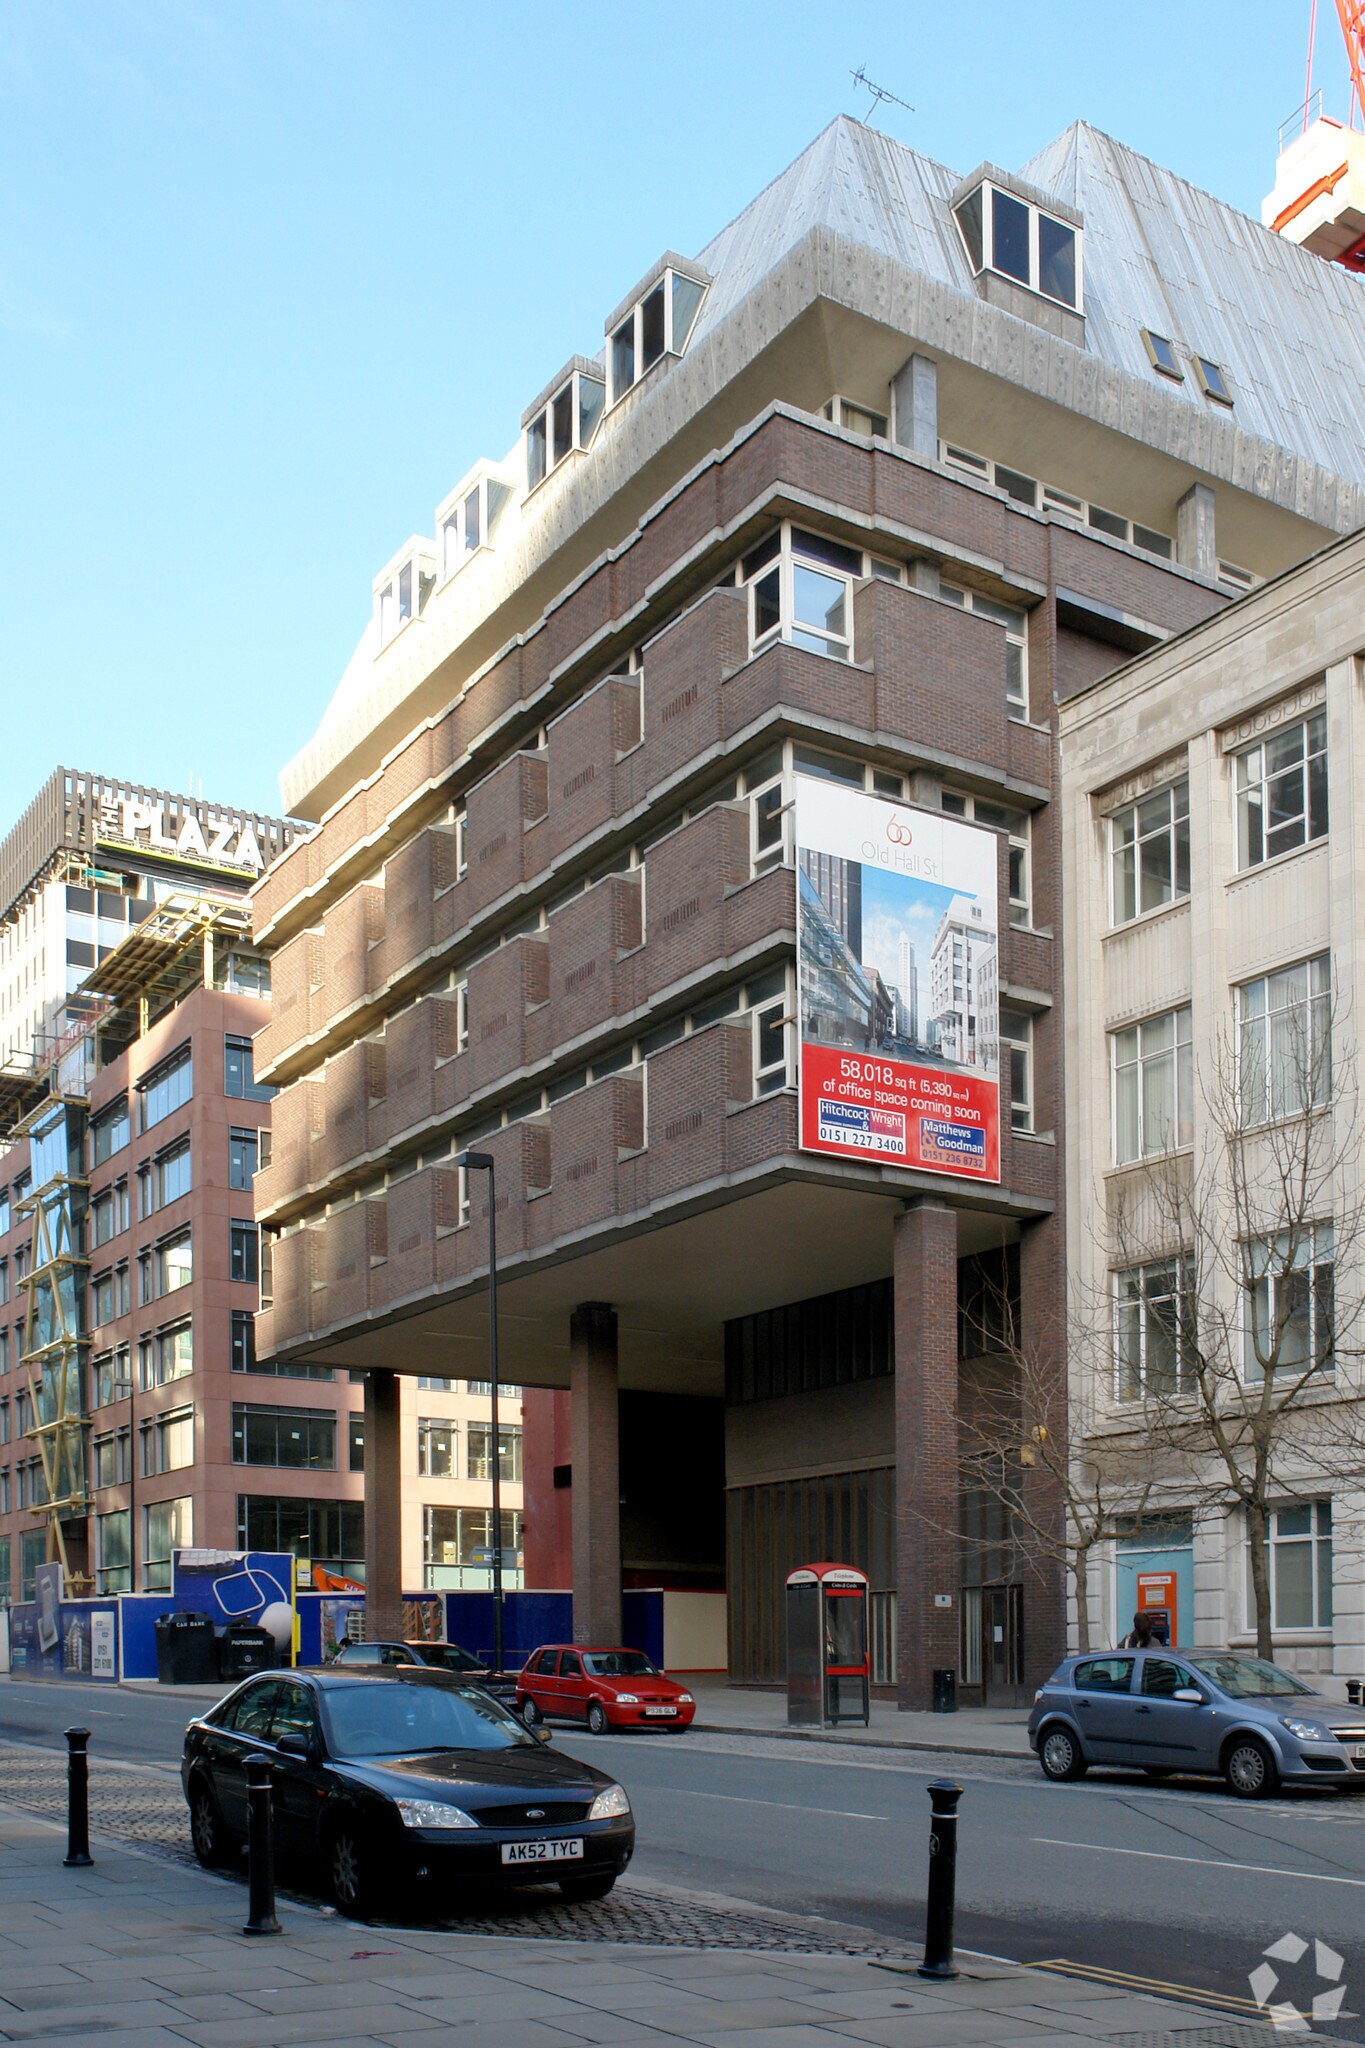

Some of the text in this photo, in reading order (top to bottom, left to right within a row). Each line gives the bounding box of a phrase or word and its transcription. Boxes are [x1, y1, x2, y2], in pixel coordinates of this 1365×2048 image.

[100, 794, 119, 832] THE
[121, 800, 267, 870] PLAZA
[886, 813, 912, 846] 60
[861, 841, 938, 878] Old Hall St
[840, 1058, 894, 1085] 58,018
[895, 1077, 907, 1091] sq
[908, 1077, 917, 1091] ft
[920, 1079, 952, 1097] (5,390
[823, 1079, 981, 1121] of office space coming soon
[821, 1102, 870, 1121] Hitchcock
[870, 1111, 902, 1127] Wright
[862, 1121, 869, 1131] &
[820, 1127, 904, 1152] 0151 227 3400
[922, 1129, 938, 1148] &
[937, 1136, 984, 1154] Goodman
[923, 1120, 972, 1139] Matthews
[922, 1148, 983, 1168] 0151 236 8732
[508, 1841, 578, 1860] AK52 TYC
